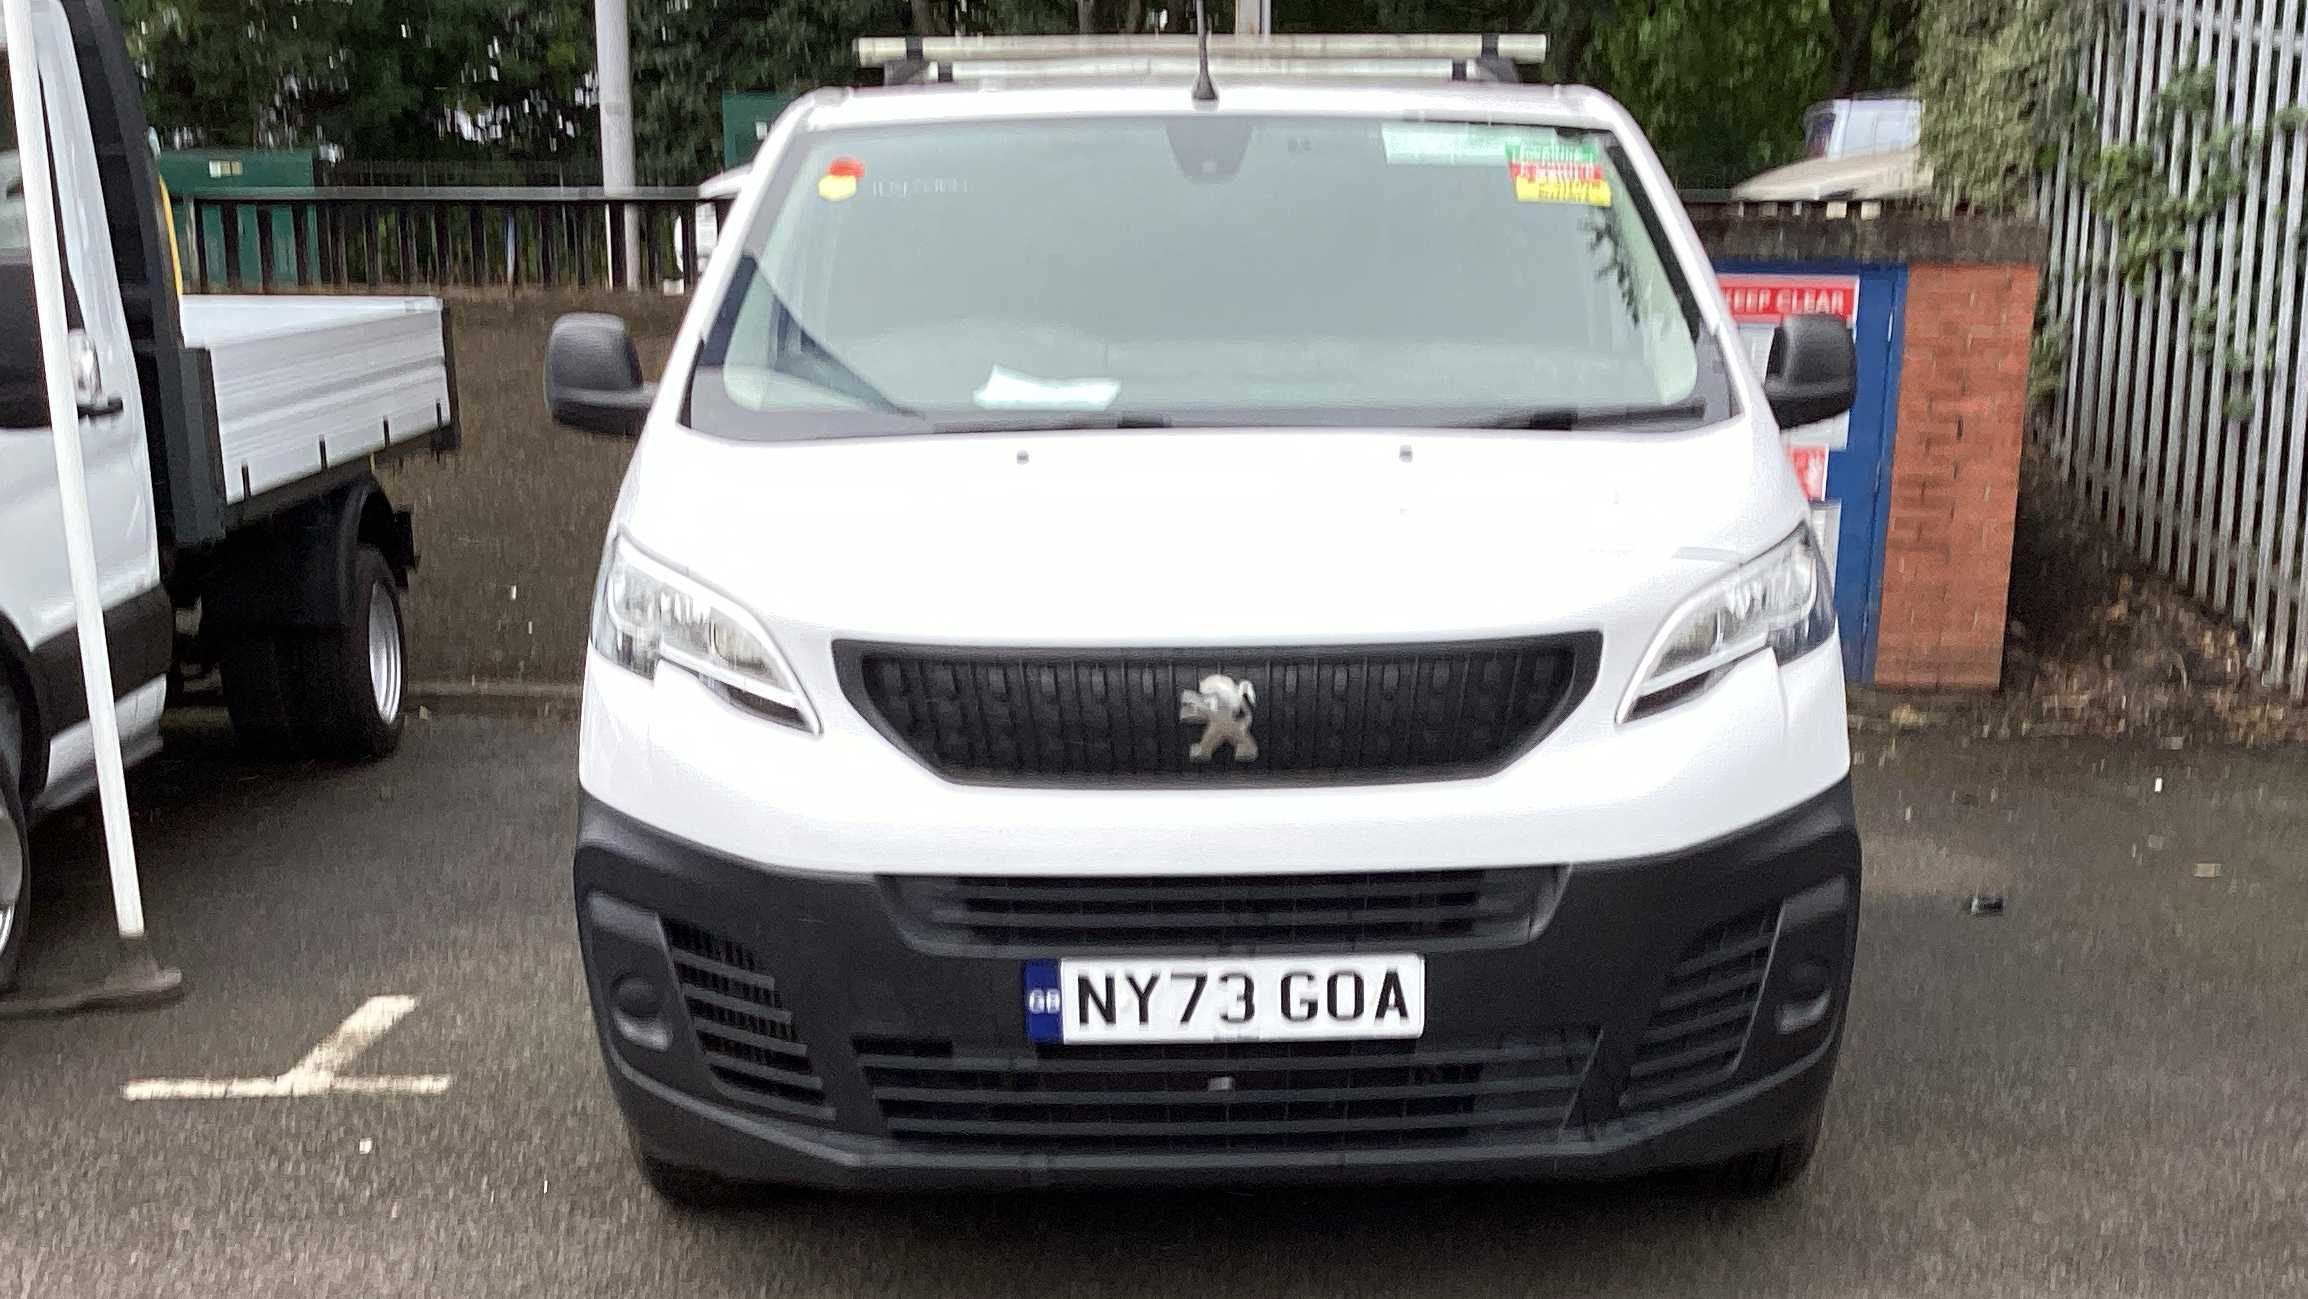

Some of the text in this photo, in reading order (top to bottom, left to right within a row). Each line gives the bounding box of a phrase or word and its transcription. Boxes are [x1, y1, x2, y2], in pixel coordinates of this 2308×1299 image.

[1776, 287, 1844, 314] CLEAR
[1029, 988, 1060, 1014] GB
[1077, 970, 1409, 1026] NY73 GOA
